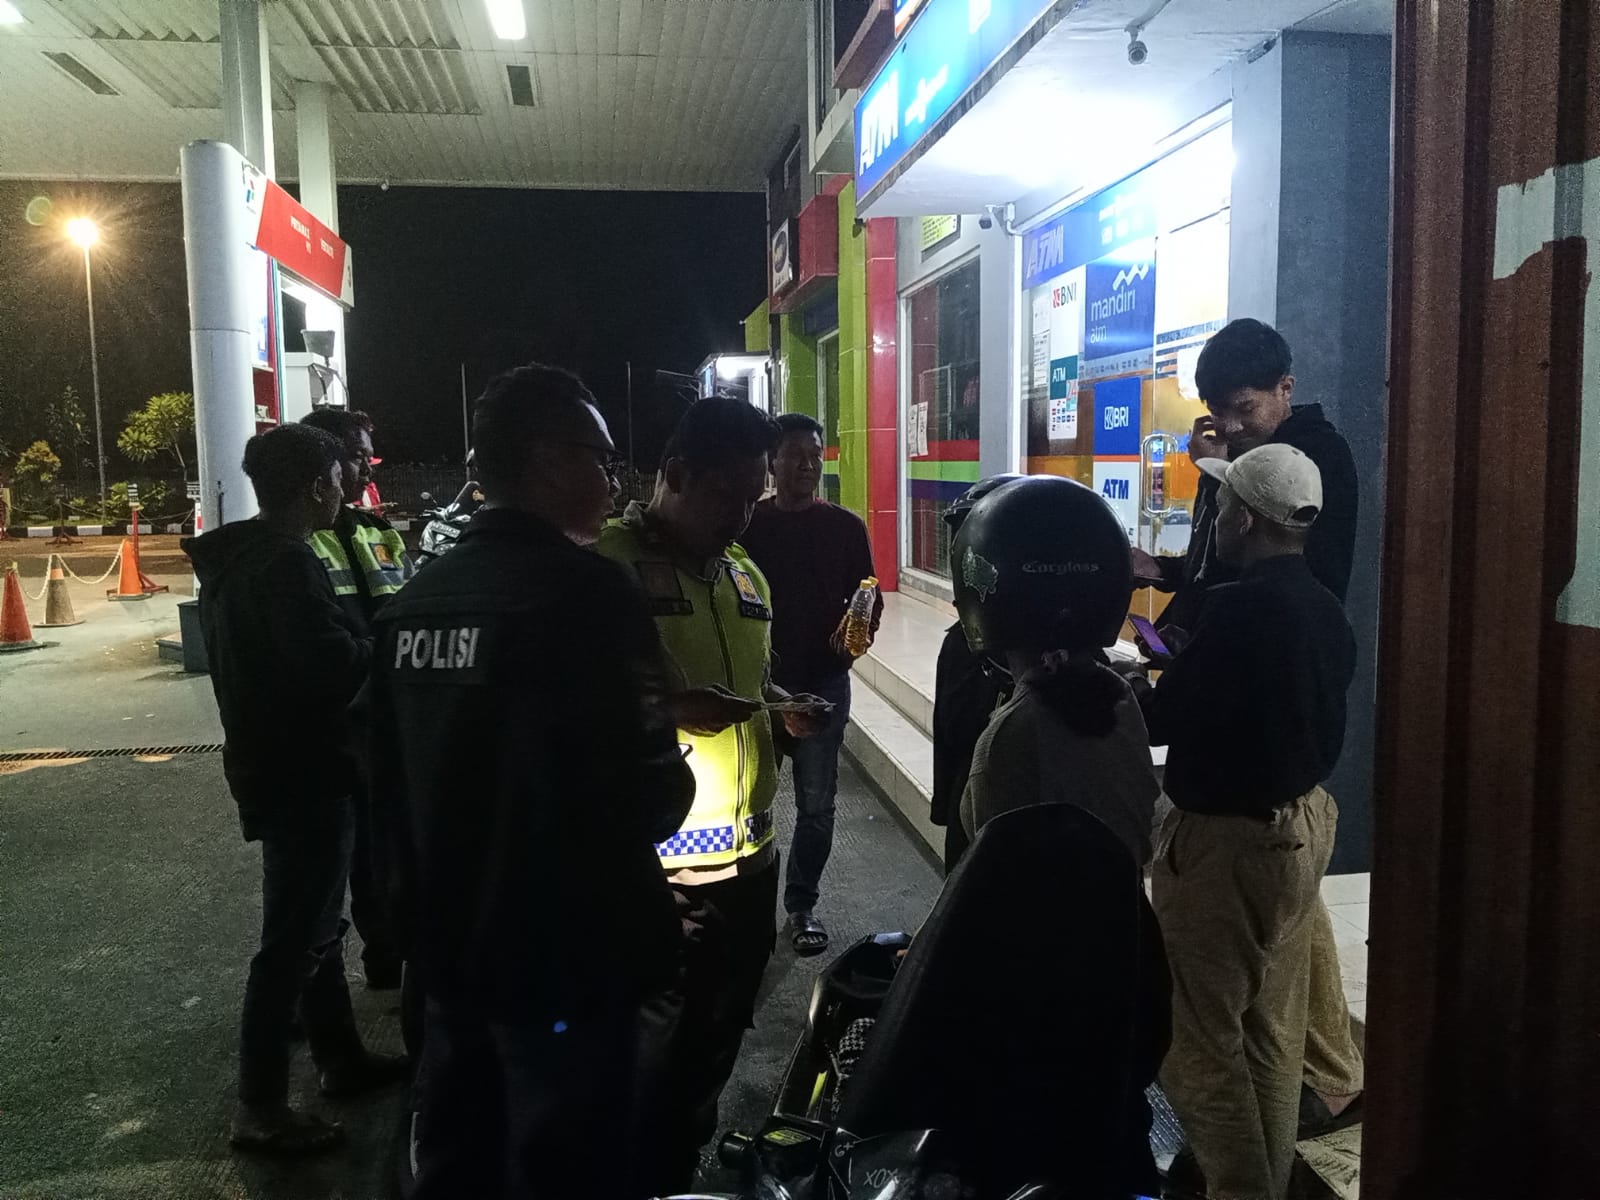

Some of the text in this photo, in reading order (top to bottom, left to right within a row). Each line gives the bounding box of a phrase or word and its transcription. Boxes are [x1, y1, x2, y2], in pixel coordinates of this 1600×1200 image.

[1026, 225, 1064, 279] ATM
[1060, 282, 1077, 308] BNI
[1091, 285, 1136, 322] mandiri
[1090, 323, 1107, 344] atm
[1052, 367, 1066, 383] ATM
[1114, 406, 1129, 428] BRI
[1102, 479, 1129, 500] ATM
[394, 627, 480, 669] POLISI
